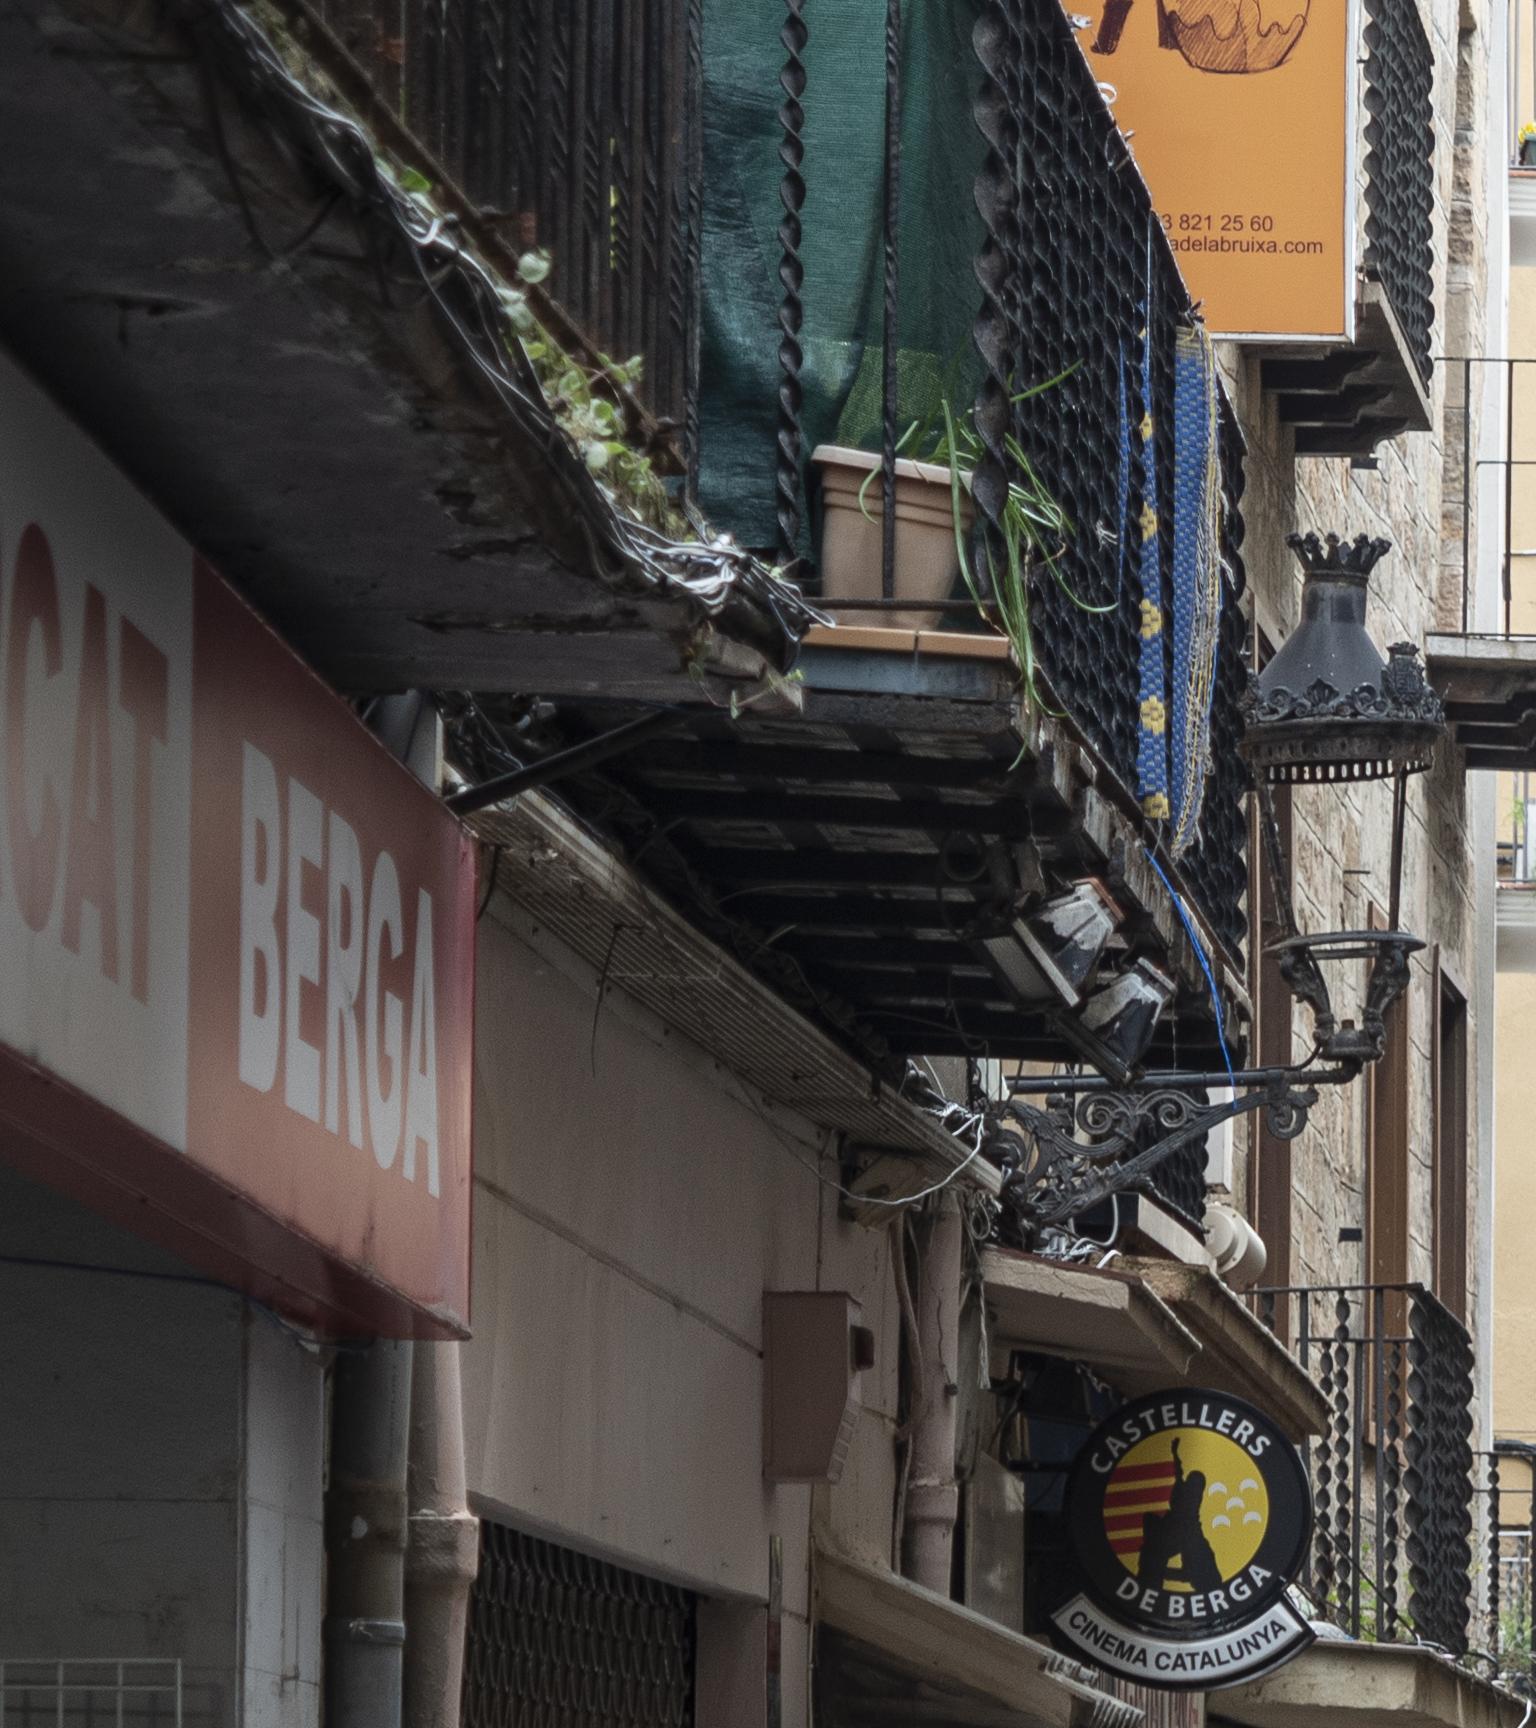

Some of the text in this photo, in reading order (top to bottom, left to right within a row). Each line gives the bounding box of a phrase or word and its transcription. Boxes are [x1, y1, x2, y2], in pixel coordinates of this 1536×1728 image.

[1178, 213, 1212, 231] 821
[1220, 214, 1244, 232] 25
[1249, 215, 1274, 232] 60
[238, 739, 440, 1198] BERGA
[1090, 1402, 1271, 1474] CASTELLERS
[1115, 1563, 1272, 1619] DE BERGA
[1068, 1610, 1287, 1672] CINEMA CATALUNYA
